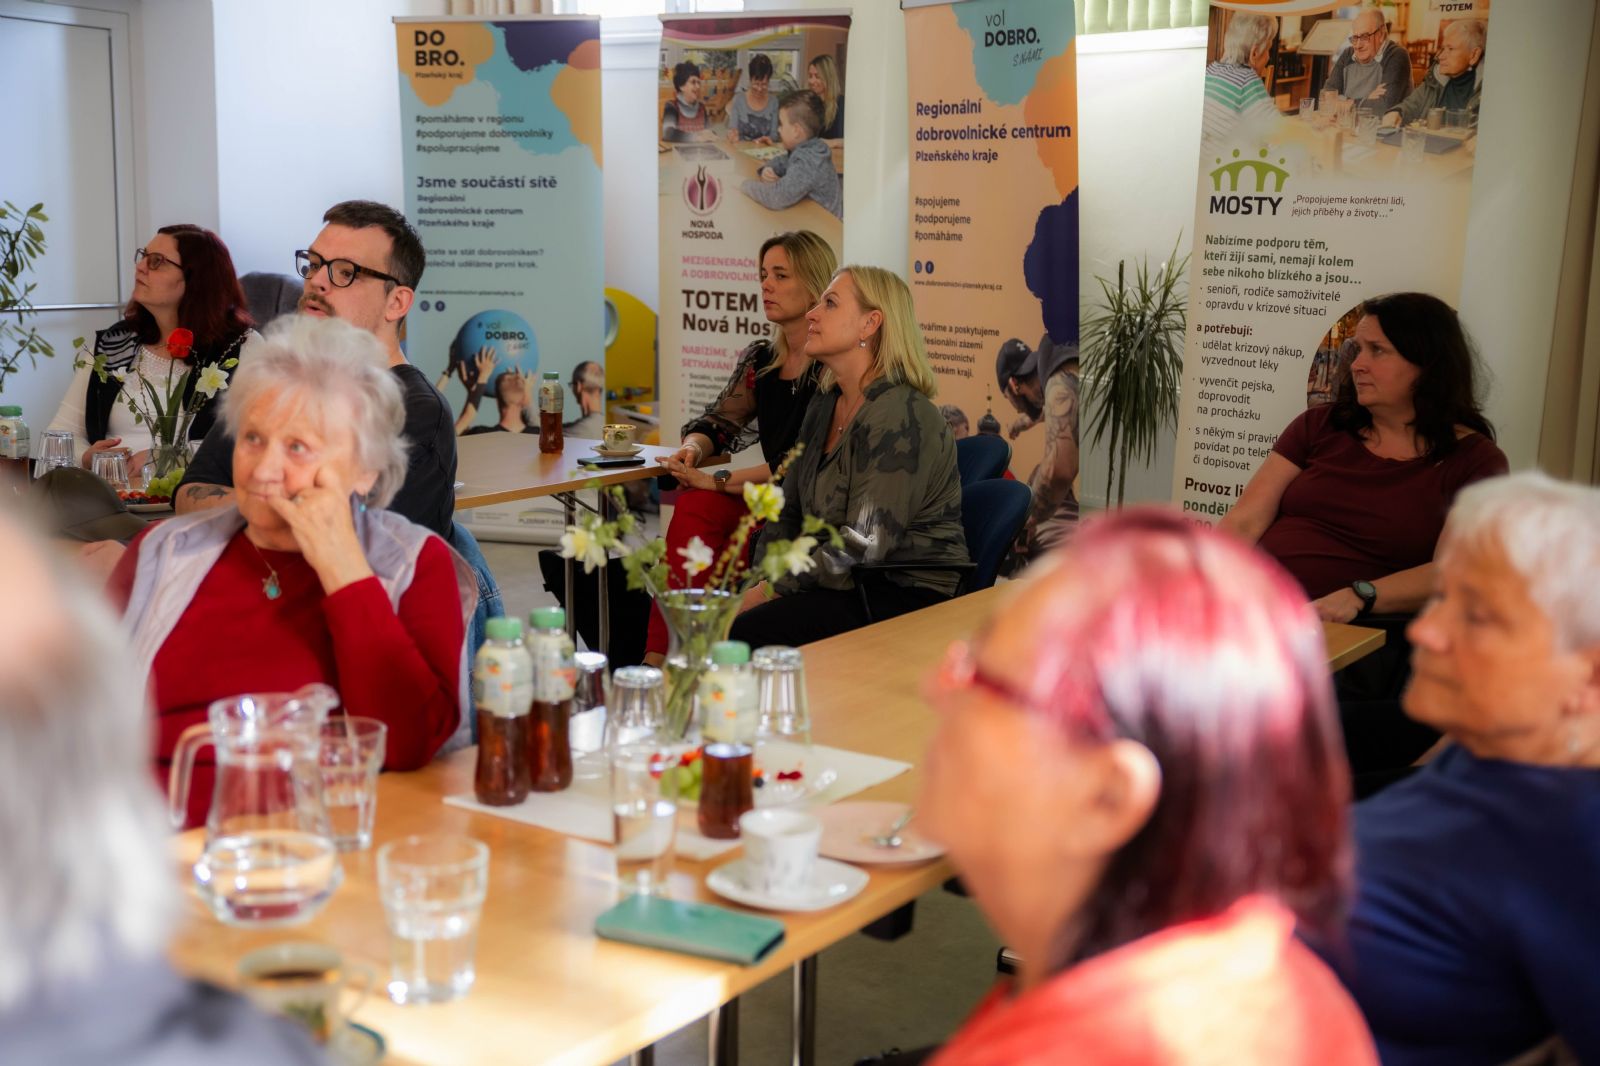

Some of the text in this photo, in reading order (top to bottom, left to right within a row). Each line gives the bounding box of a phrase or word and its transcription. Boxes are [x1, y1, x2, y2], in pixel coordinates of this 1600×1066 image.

[1440, 3, 1472, 12] TOTEM
[986, 10, 1005, 27] vol
[414, 30, 445, 46] DO
[984, 27, 1041, 47] DOBRO.
[415, 50, 465, 66] BRO.
[916, 98, 981, 118] Regionální
[416, 114, 475, 124] #pomáháme
[486, 115, 524, 124] regionu
[416, 130, 486, 139] #podporujeme
[916, 124, 1071, 141] dobrovolnické centrum
[416, 144, 500, 154] #spolupracujeme
[916, 149, 998, 163] Plzeňského kraje
[417, 175, 557, 188] Jsme součástí sítě
[417, 194, 466, 203] Regionální
[915, 196, 960, 208] #spojujeme
[1209, 196, 1283, 215] MOSTY
[1350, 195, 1389, 205] konkrétní
[1391, 196, 1405, 206] lidí,
[417, 206, 482, 215] dobrovolnické
[1291, 207, 1311, 217] jejich
[1313, 207, 1344, 218] příběhy
[417, 219, 495, 228] Plzeňského kraje
[690, 219, 715, 229] NOVÁ
[915, 213, 971, 226] #podporujeme
[682, 231, 723, 240] HOSPODA
[915, 230, 963, 242] #pomáháme
[1205, 234, 1329, 251] Nabízíme podporu těm,
[682, 255, 756, 268] MEZIGENERAČN
[1204, 249, 1354, 267] kteří žijí sami, nemají kolem
[682, 269, 759, 281] A DOBROVOLNIC
[1202, 267, 1225, 277] sebe
[1227, 268, 1265, 279] nikoho
[1267, 269, 1312, 282] blízkého
[1315, 274, 1322, 282] a
[1207, 284, 1341, 301] senioři, rodiče samoživitelé
[682, 289, 758, 312] TOTEM
[1205, 299, 1244, 312] opravdu
[1293, 304, 1327, 316] situaci
[683, 313, 771, 336] Nová Hos
[919, 323, 947, 332] tváříme
[954, 325, 1000, 337] poskytujeme
[1196, 323, 1253, 336] a potřebují:
[485, 331, 528, 341] DOBRO.
[924, 336, 983, 349] fesionální zázemí
[1202, 339, 1232, 350] udělat
[1272, 345, 1305, 359] nákup,
[1201, 356, 1279, 371] vyzvednout léky
[1199, 377, 1275, 393] vyvenčit pejska,
[1198, 390, 1251, 405] doprovodit
[1197, 406, 1261, 421] na procházku
[1195, 426, 1278, 444] s někým si pravid
[1194, 441, 1270, 458] povídat po telef
[1193, 455, 1250, 471] či dopisovat
[1185, 477, 1244, 497] Provoz li
